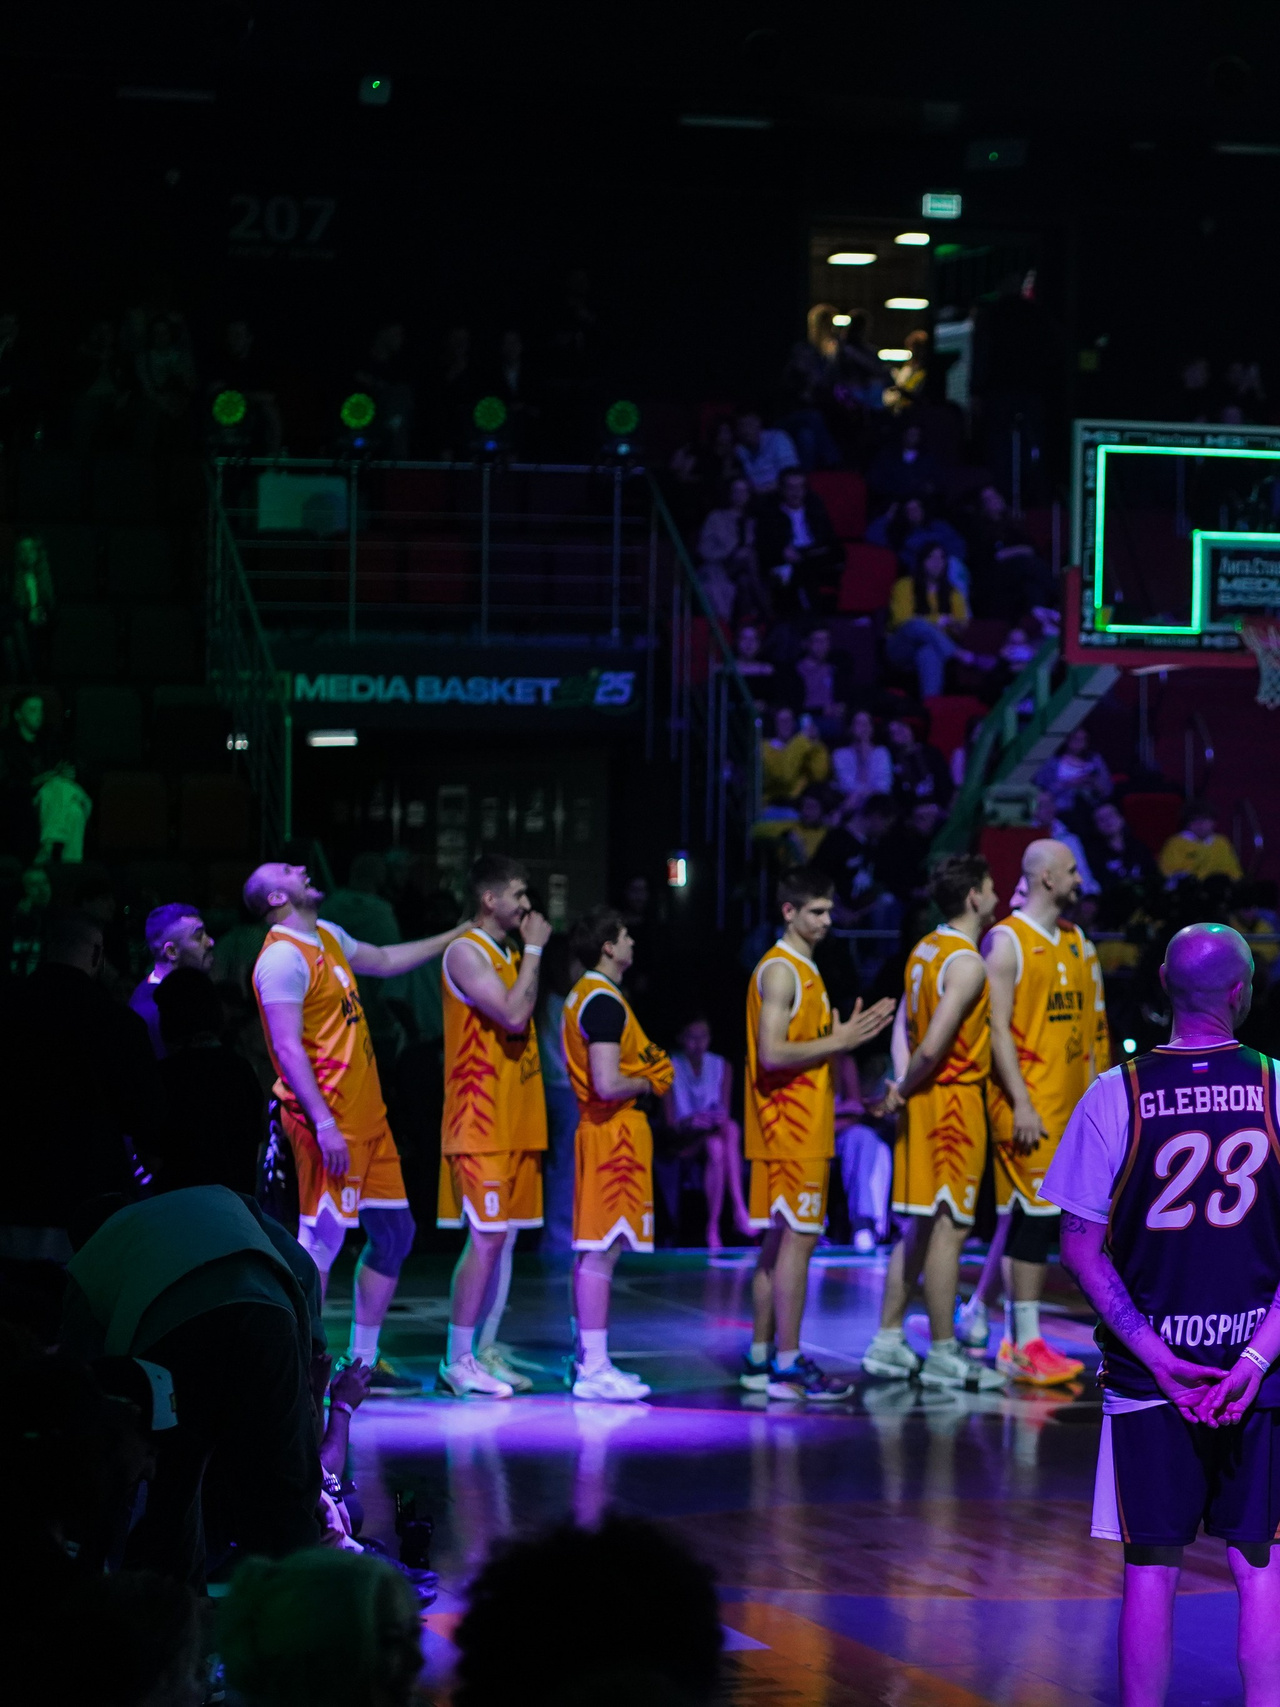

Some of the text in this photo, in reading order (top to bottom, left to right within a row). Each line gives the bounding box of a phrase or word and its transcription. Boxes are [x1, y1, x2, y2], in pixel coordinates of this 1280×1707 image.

[229, 193, 338, 243] 207
[295, 672, 412, 704] MEDIA
[415, 674, 561, 706] BASKET
[1139, 1085, 1265, 1119] GLEBRON
[1145, 1126, 1271, 1231] 23
